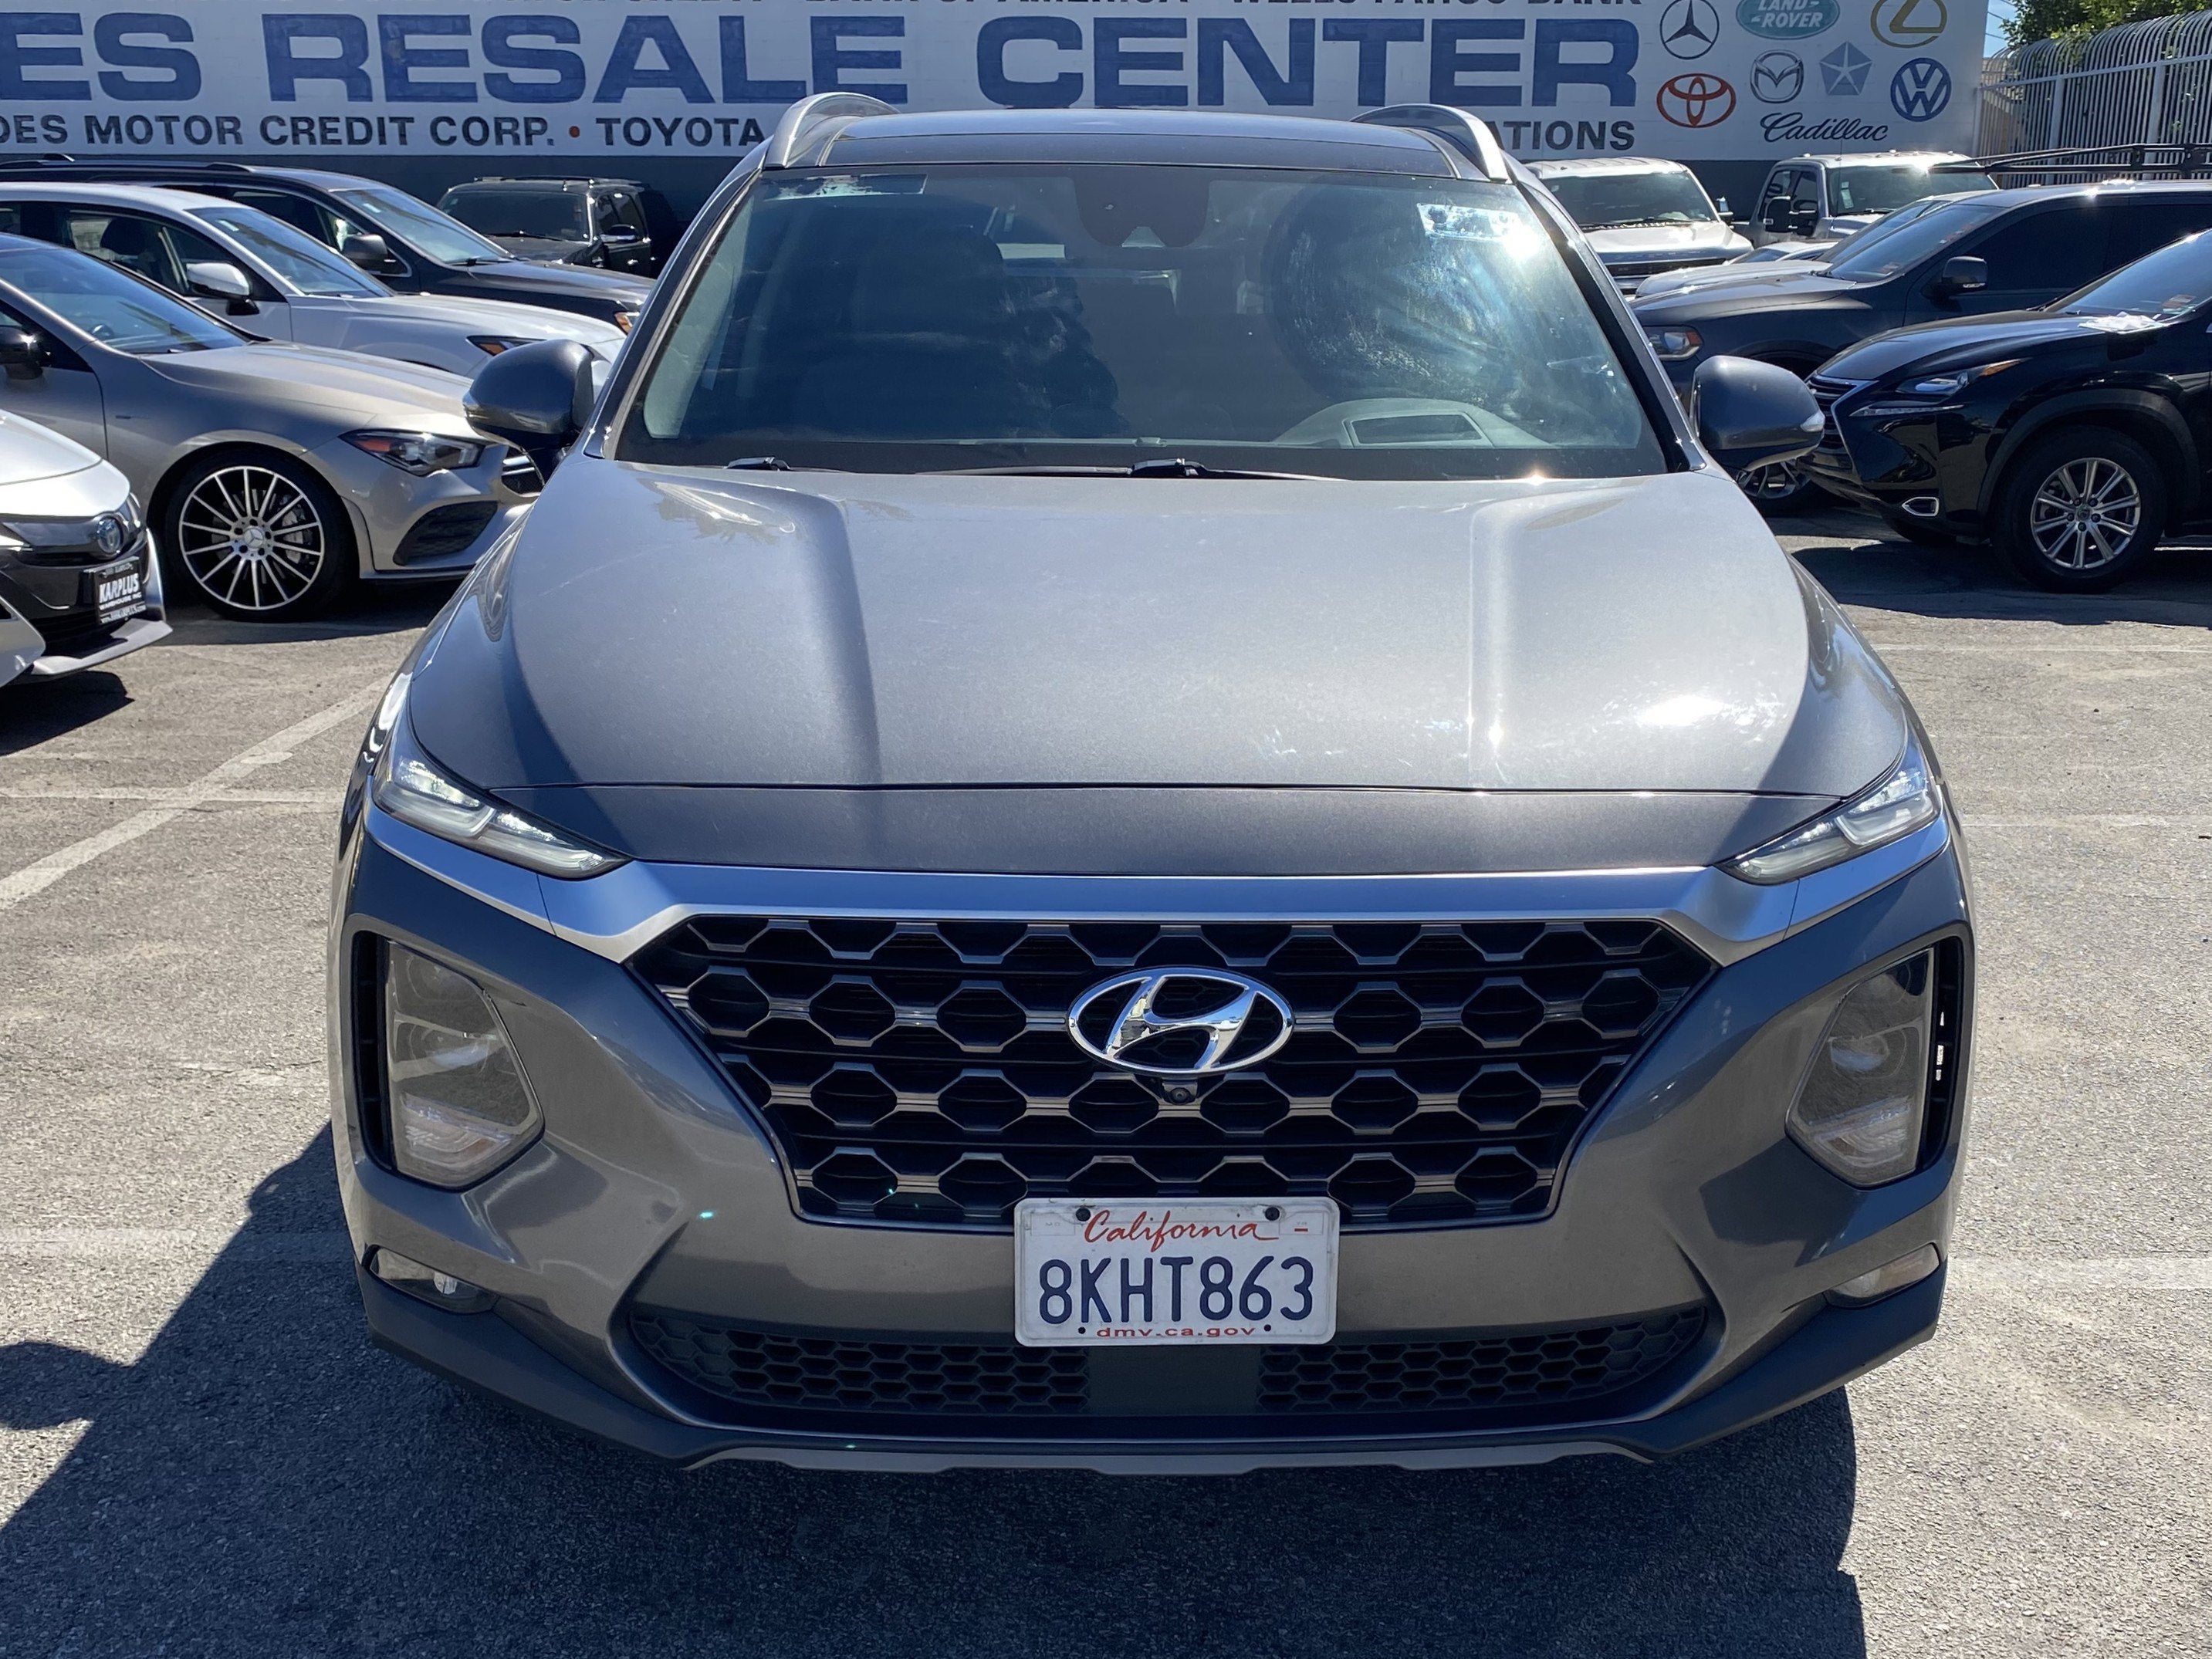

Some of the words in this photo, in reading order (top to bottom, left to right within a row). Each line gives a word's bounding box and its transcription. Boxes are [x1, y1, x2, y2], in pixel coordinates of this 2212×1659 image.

[1758, 0, 1808, 11] LAND
[1761, 12, 1823, 28] ROVER
[262, 13, 908, 104] RESALE
[976, 16, 1640, 108] CENTER
[84, 115, 243, 146] MOTOR
[259, 115, 414, 146] CREDIT
[429, 116, 555, 147] CORP.
[595, 117, 766, 147] TOYOTA
[1760, 112, 1889, 143] Cadillac
[99, 573, 140, 603] KARPLUS
[1084, 1210, 1280, 1252] California
[1039, 1255, 1314, 1324] 8KHT863
[1096, 1326, 1256, 1338] dmv.ca.gov
